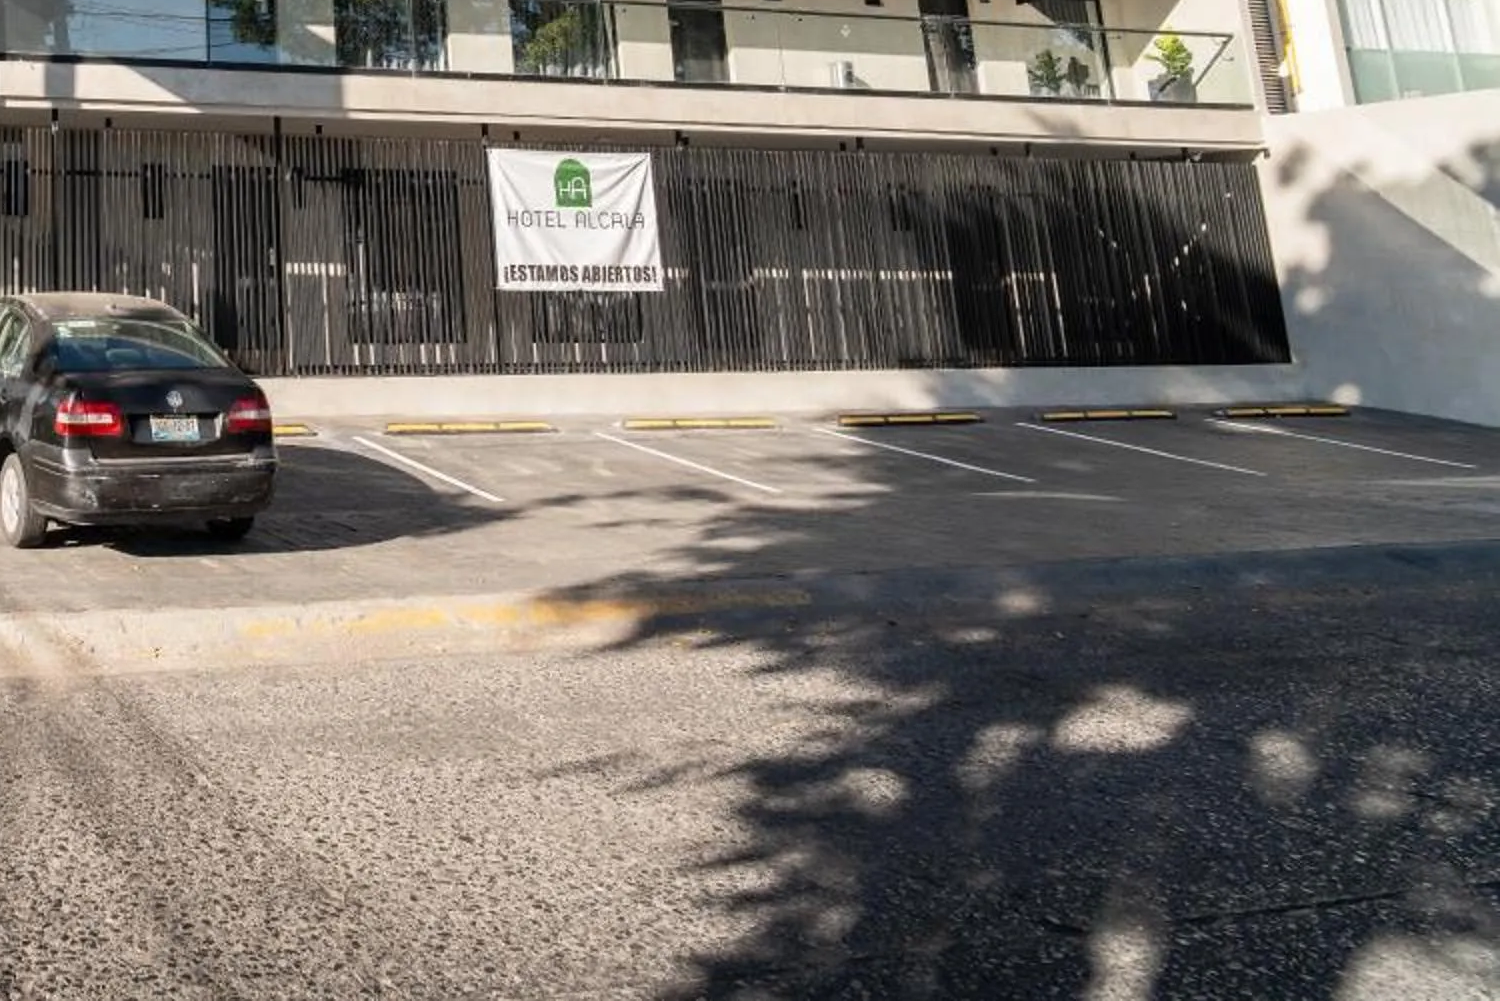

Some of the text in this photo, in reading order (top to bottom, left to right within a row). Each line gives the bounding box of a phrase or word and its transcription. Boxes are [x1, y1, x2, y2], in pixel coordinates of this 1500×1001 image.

[507, 210, 566, 228] HOTEL
[503, 264, 657, 284] ¡ESTAMOS ABIERTOS!
